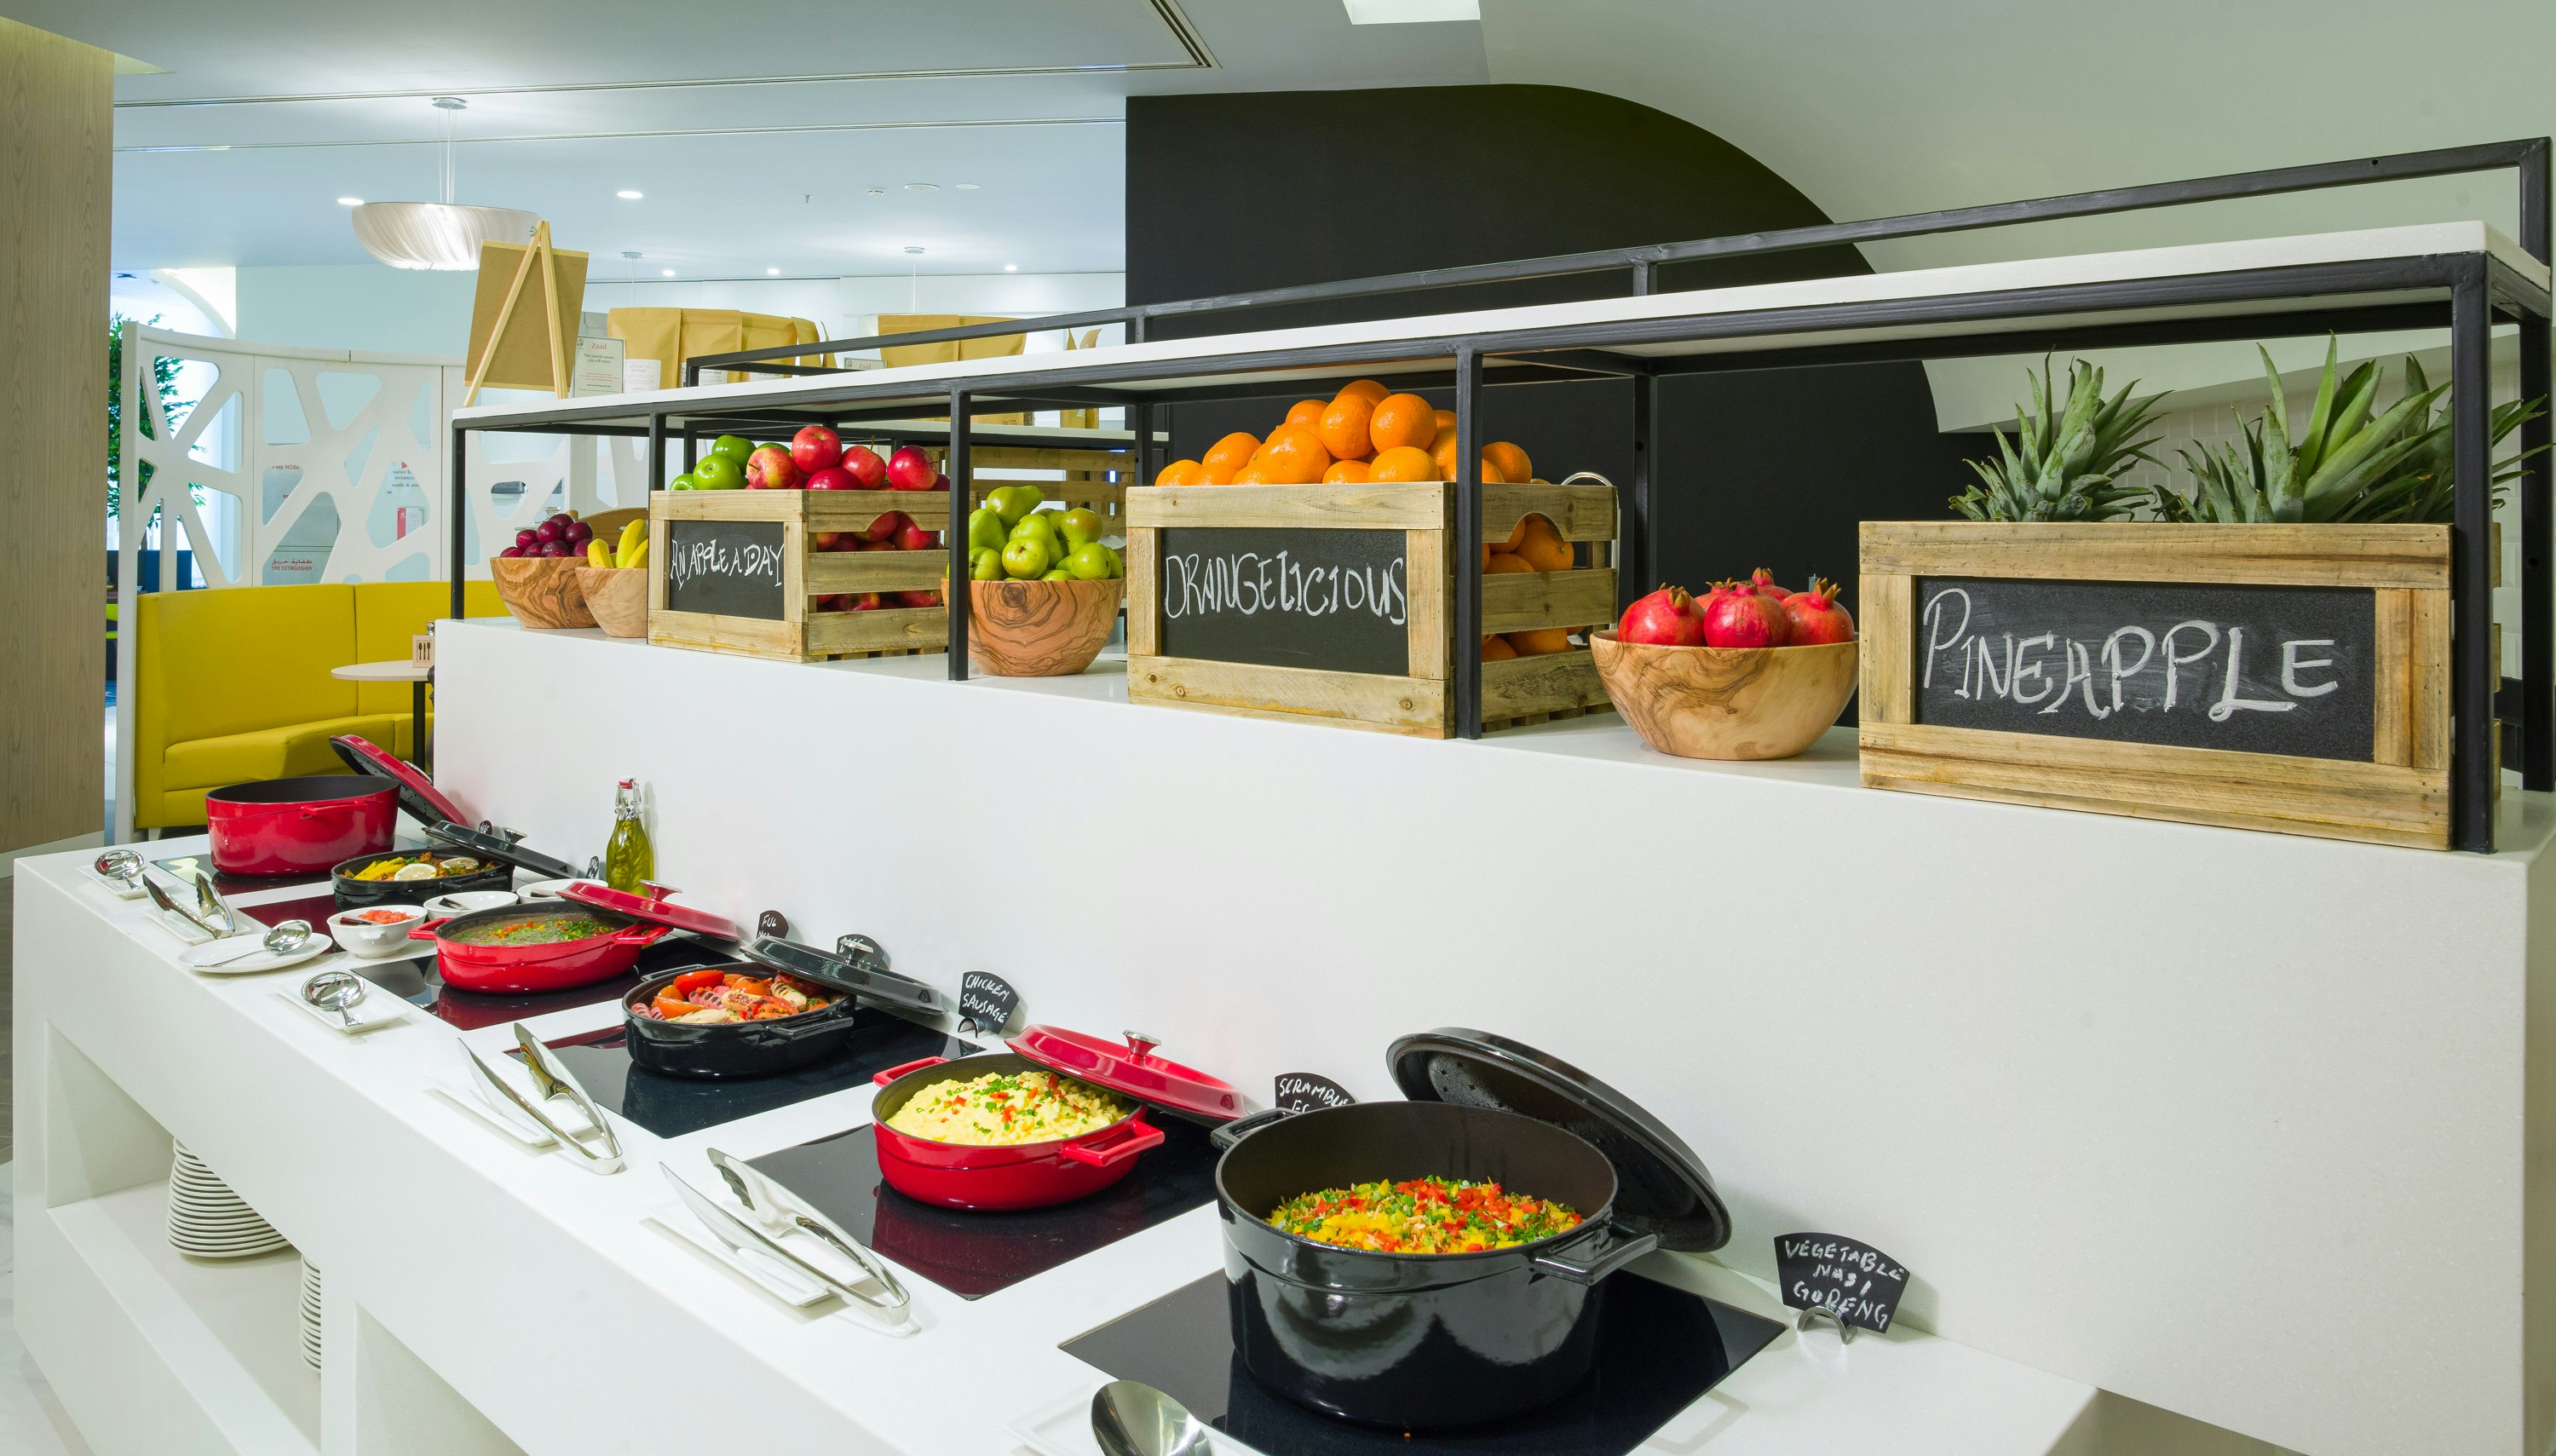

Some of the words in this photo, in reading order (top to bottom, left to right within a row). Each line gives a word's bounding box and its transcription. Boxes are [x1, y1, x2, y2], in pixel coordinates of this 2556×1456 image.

[671, 538, 686, 590] AN
[687, 538, 730, 581] APPLE
[728, 547, 743, 577] A
[744, 544, 785, 587] DAY
[1165, 550, 1406, 625] ORANGELICIOUS
[1923, 587, 2339, 722] PINEAPPLE
[761, 914, 777, 928] FUL
[962, 993, 1009, 1024] SAUSAGE
[964, 974, 1010, 1002] CHICKEN
[1784, 1240, 1905, 1281] VEGETABLE
[1812, 1263, 1873, 1298] NASI
[1793, 1280, 1889, 1330] GORENG
